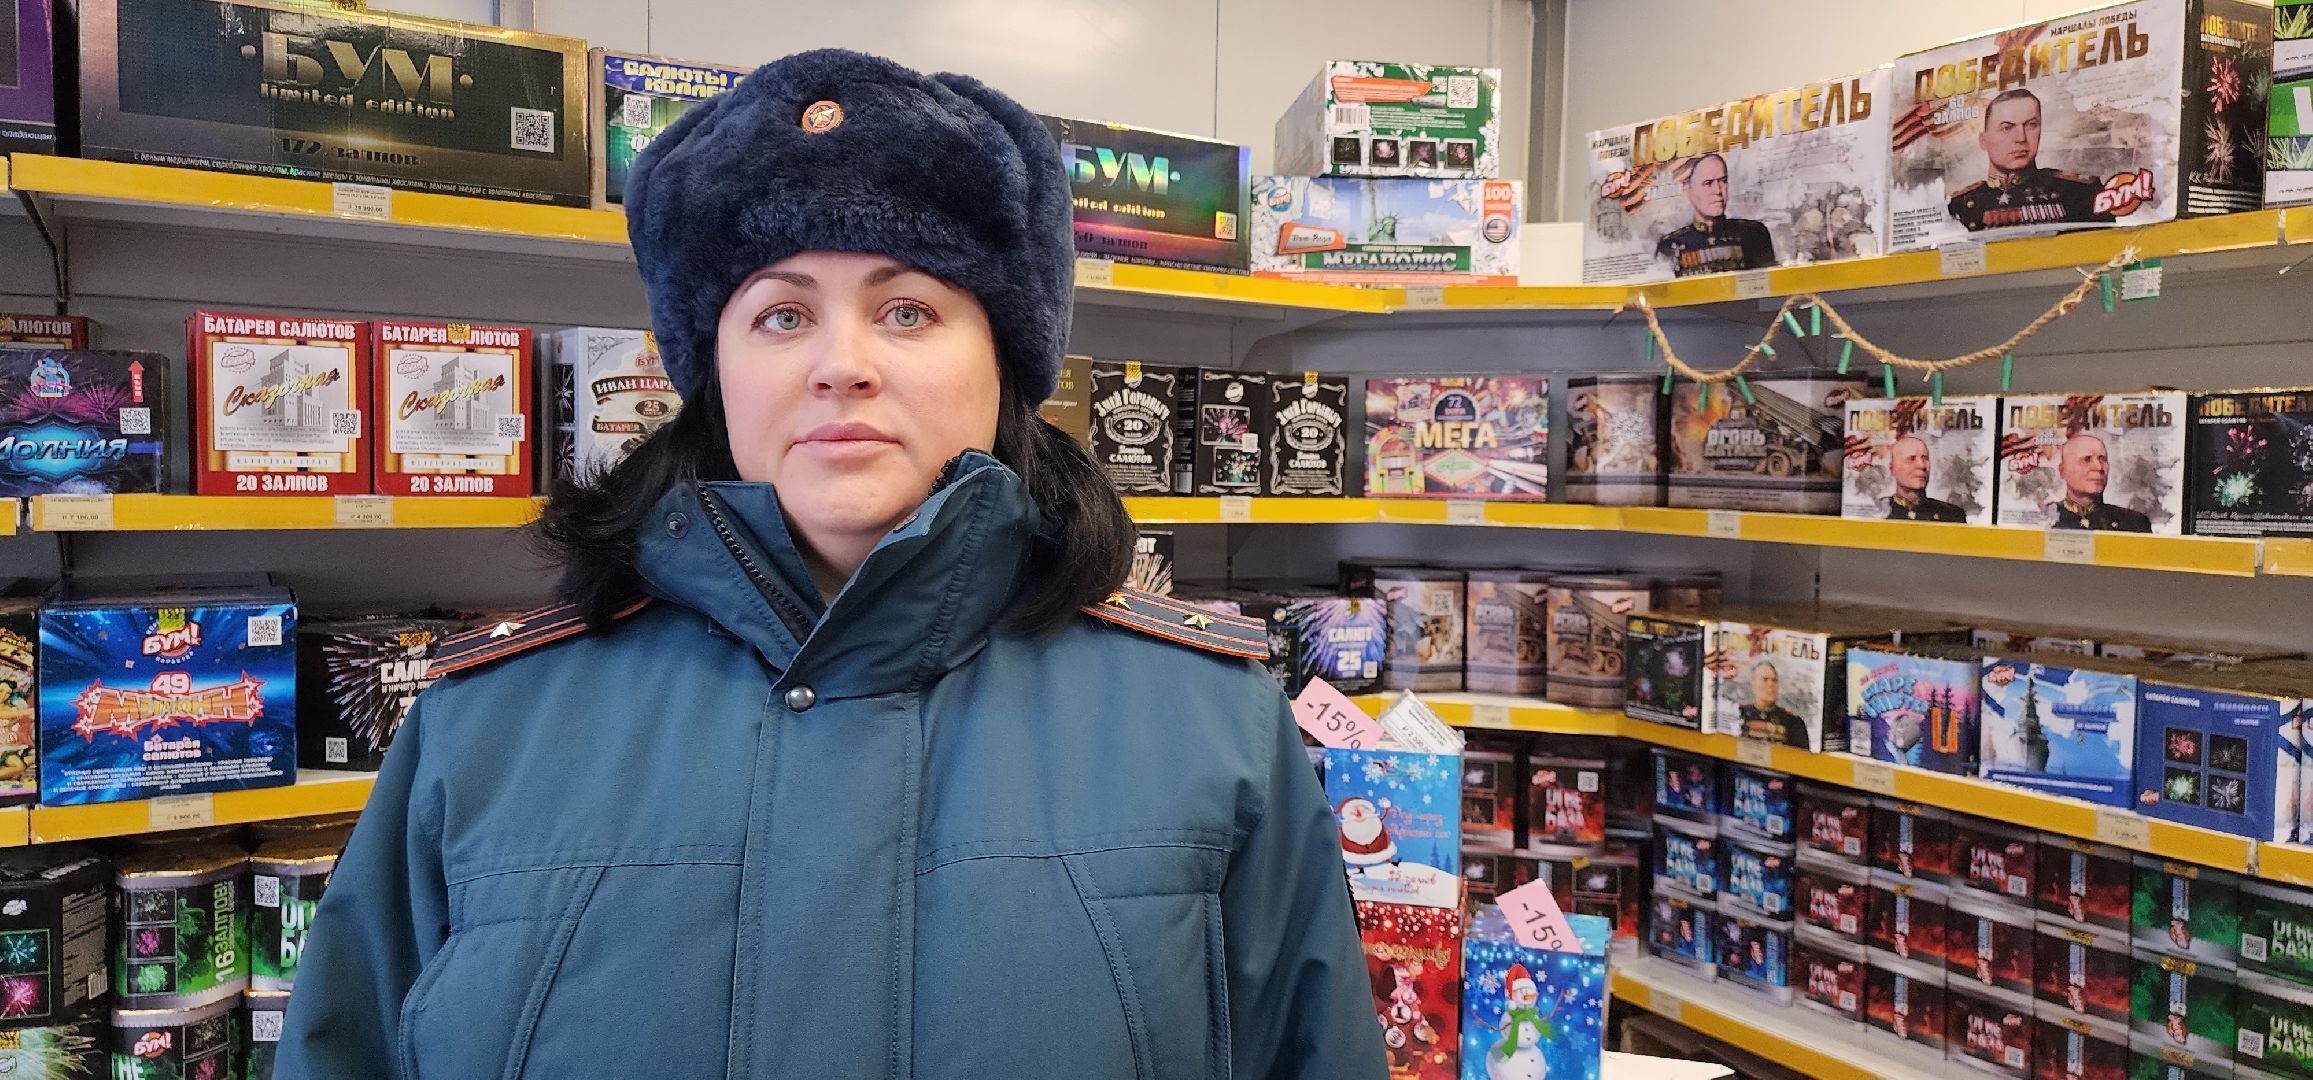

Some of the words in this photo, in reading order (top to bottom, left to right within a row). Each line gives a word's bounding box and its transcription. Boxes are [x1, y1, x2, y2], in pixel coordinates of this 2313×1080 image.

[263, 32, 453, 104] БУМ
[623, 61, 728, 87] САЛЮТЫ
[1914, 23, 2150, 104] ПОБЕДИТЕЛЬ
[261, 83, 354, 109] limited
[365, 98, 456, 119] edition
[1632, 78, 1873, 169] ПОБЕДИТЕЛЬ
[1061, 142, 1170, 195] БУМ
[2093, 168, 2154, 215] БУМ!
[204, 317, 276, 336] БАТАРЕЯ
[280, 321, 356, 339] САЛЮТОВ
[382, 325, 447, 344] БАТАРЕЯ
[452, 330, 520, 346] ЛЮТОВ
[595, 379, 637, 395] ИВАН
[1850, 408, 1983, 432] ПОБЕДИТЕЛЬ
[2009, 403, 2172, 430] ПОБЕДИТЕЛЬ
[1414, 421, 1498, 448] МЕГА
[236, 474, 258, 491] 20
[262, 475, 328, 492] ЗАЛПОВ
[410, 476, 430, 493] 20
[433, 476, 494, 493] ЗАЛПОВ
[143, 621, 201, 656] БУМ!
[1337, 651, 1362, 671] 25
[152, 674, 190, 694] 49
[1306, 701, 1362, 750] -15%
[215, 951, 235, 981] 16
